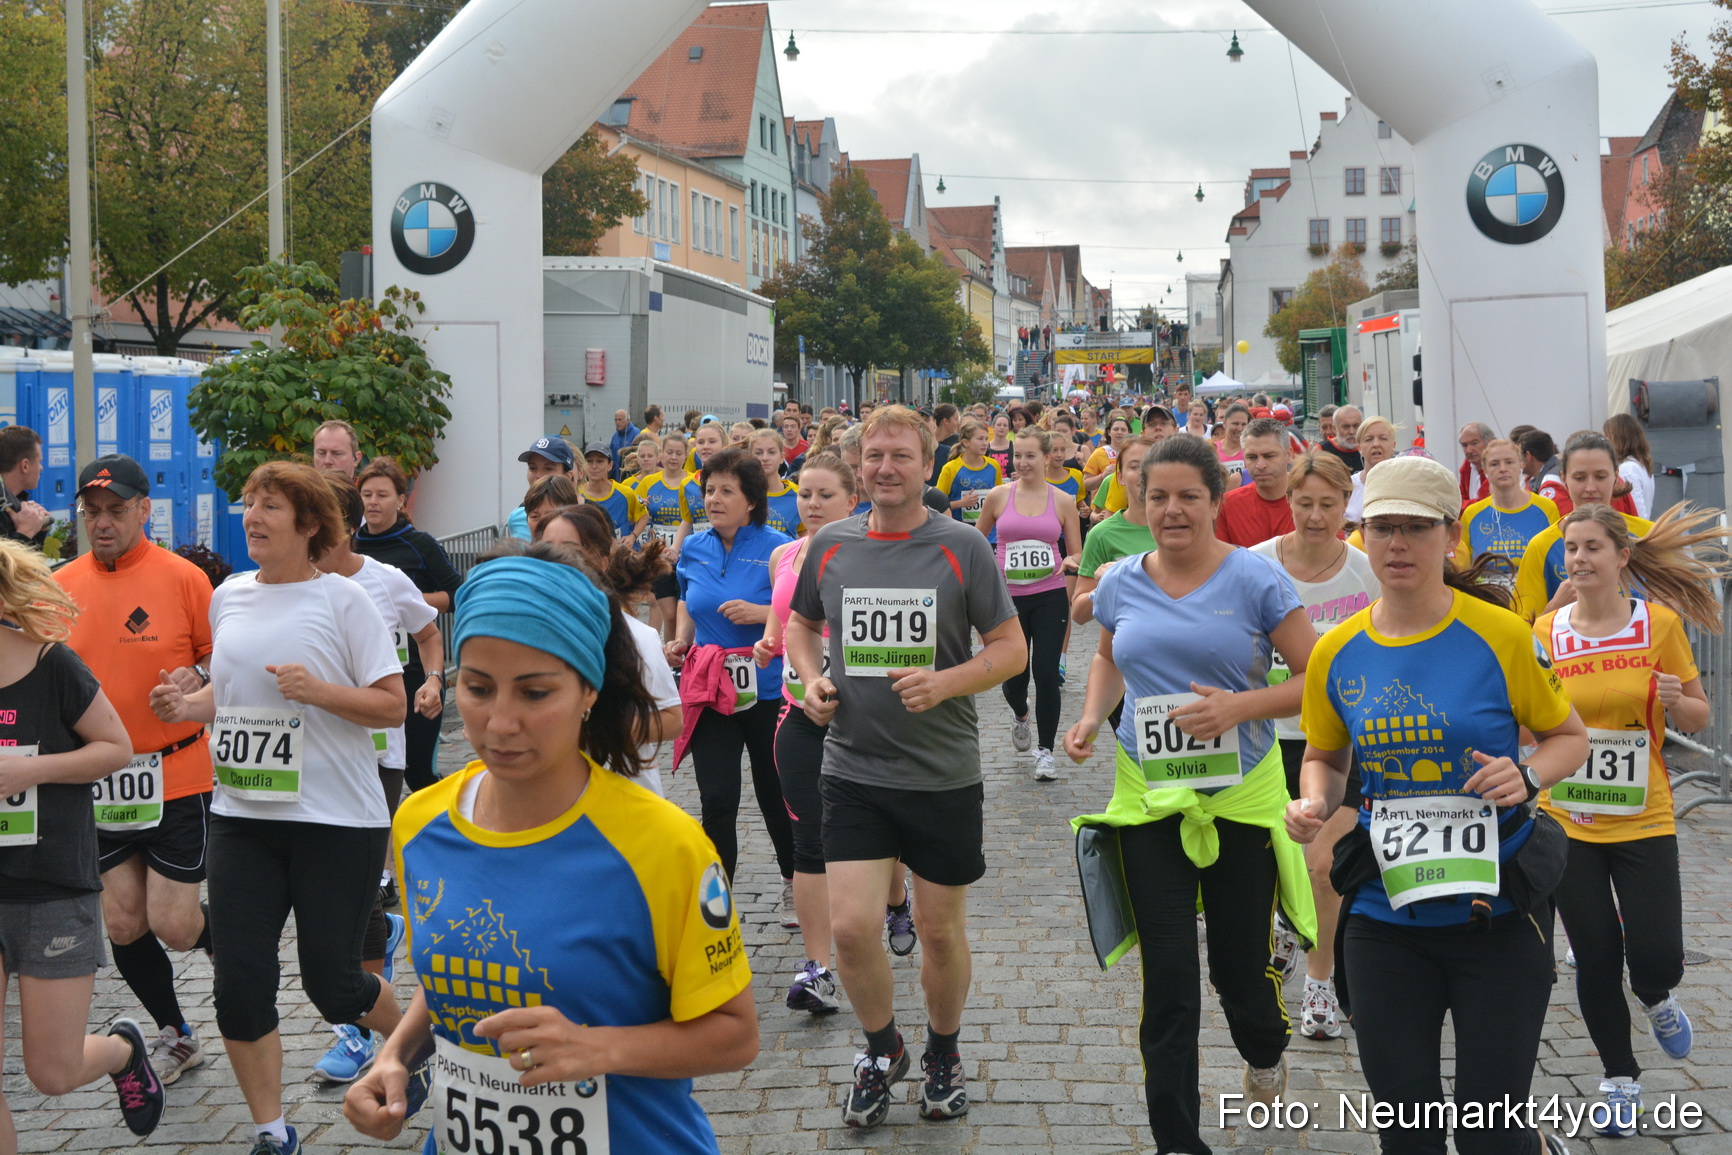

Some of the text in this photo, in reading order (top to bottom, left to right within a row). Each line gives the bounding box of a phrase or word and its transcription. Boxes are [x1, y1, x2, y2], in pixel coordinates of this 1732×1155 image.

[1473, 145, 1558, 181] BMW
[396, 183, 468, 215] BMW
[1087, 352, 1121, 361] START
[1010, 550, 1050, 568] 5169
[1023, 571, 1036, 579] Lea
[844, 597, 919, 606] PARTL Neumarkt
[851, 610, 927, 643] 5019
[119, 635, 159, 643] FliesenEichl
[850, 651, 926, 666] Hans-Jürgen
[1556, 654, 1652, 679] MAX BÖGL
[1347, 679, 1356, 687] 15
[1343, 688, 1360, 696] Jahre
[1136, 705, 1165, 716] PARTL
[215, 716, 285, 727] PARTL Neumarkt
[216, 729, 293, 765] 5074
[1422, 746, 1445, 754] 2014
[1166, 760, 1207, 778] Sylvia
[1568, 748, 1635, 782] 131
[230, 771, 273, 787] Claudia
[1567, 786, 1627, 803] Katharina
[101, 808, 138, 820] Eduard
[1374, 809, 1474, 821] PARTL Neumarkt
[1382, 821, 1486, 862] 5210
[1415, 866, 1446, 883] Bea
[417, 880, 430, 889] 15
[50, 936, 77, 948] NIKE
[437, 1053, 566, 1097] PARTL Neumarkt
[446, 1087, 588, 1155] 5538
